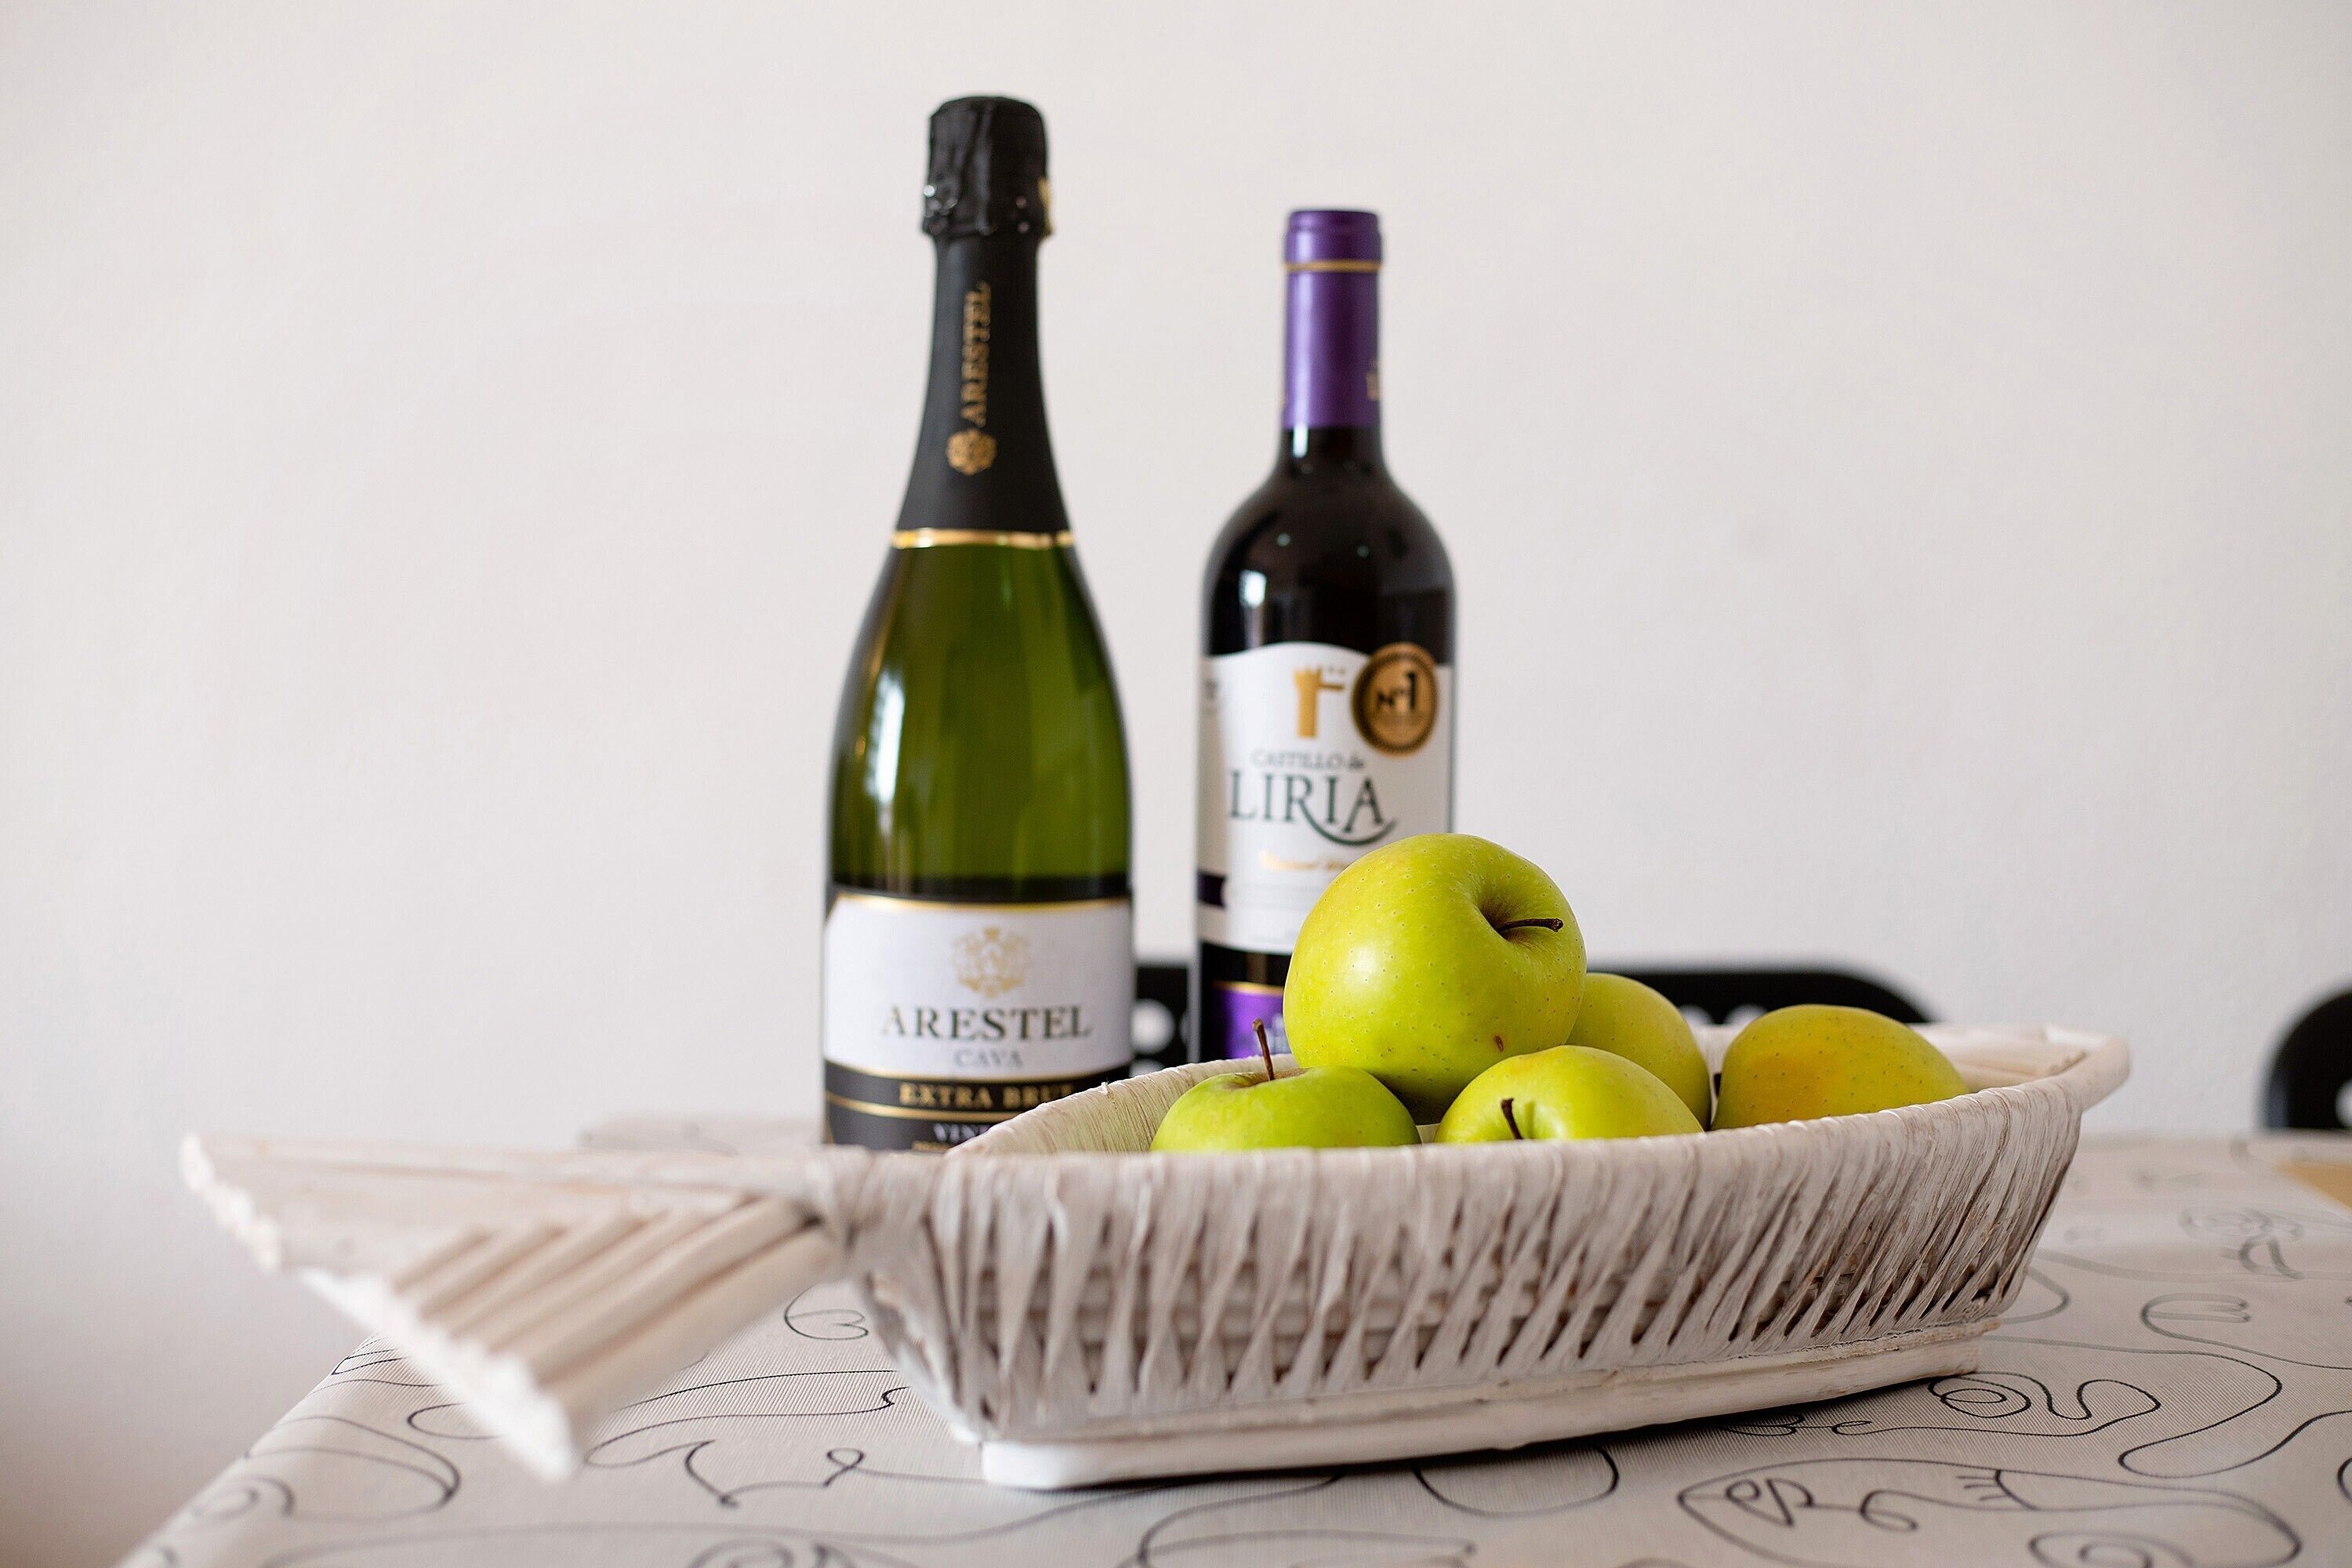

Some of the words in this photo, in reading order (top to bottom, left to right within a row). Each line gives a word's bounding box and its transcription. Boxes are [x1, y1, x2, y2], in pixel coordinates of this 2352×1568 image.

[960, 279, 991, 427] ARESTEL
[1251, 749, 1343, 769] CASTILLO
[1229, 769, 1397, 847] LIRIA
[881, 1003, 1094, 1042] ARESTEL
[953, 1047, 1023, 1069] CAVA
[899, 1081, 993, 1109] EXTRA
